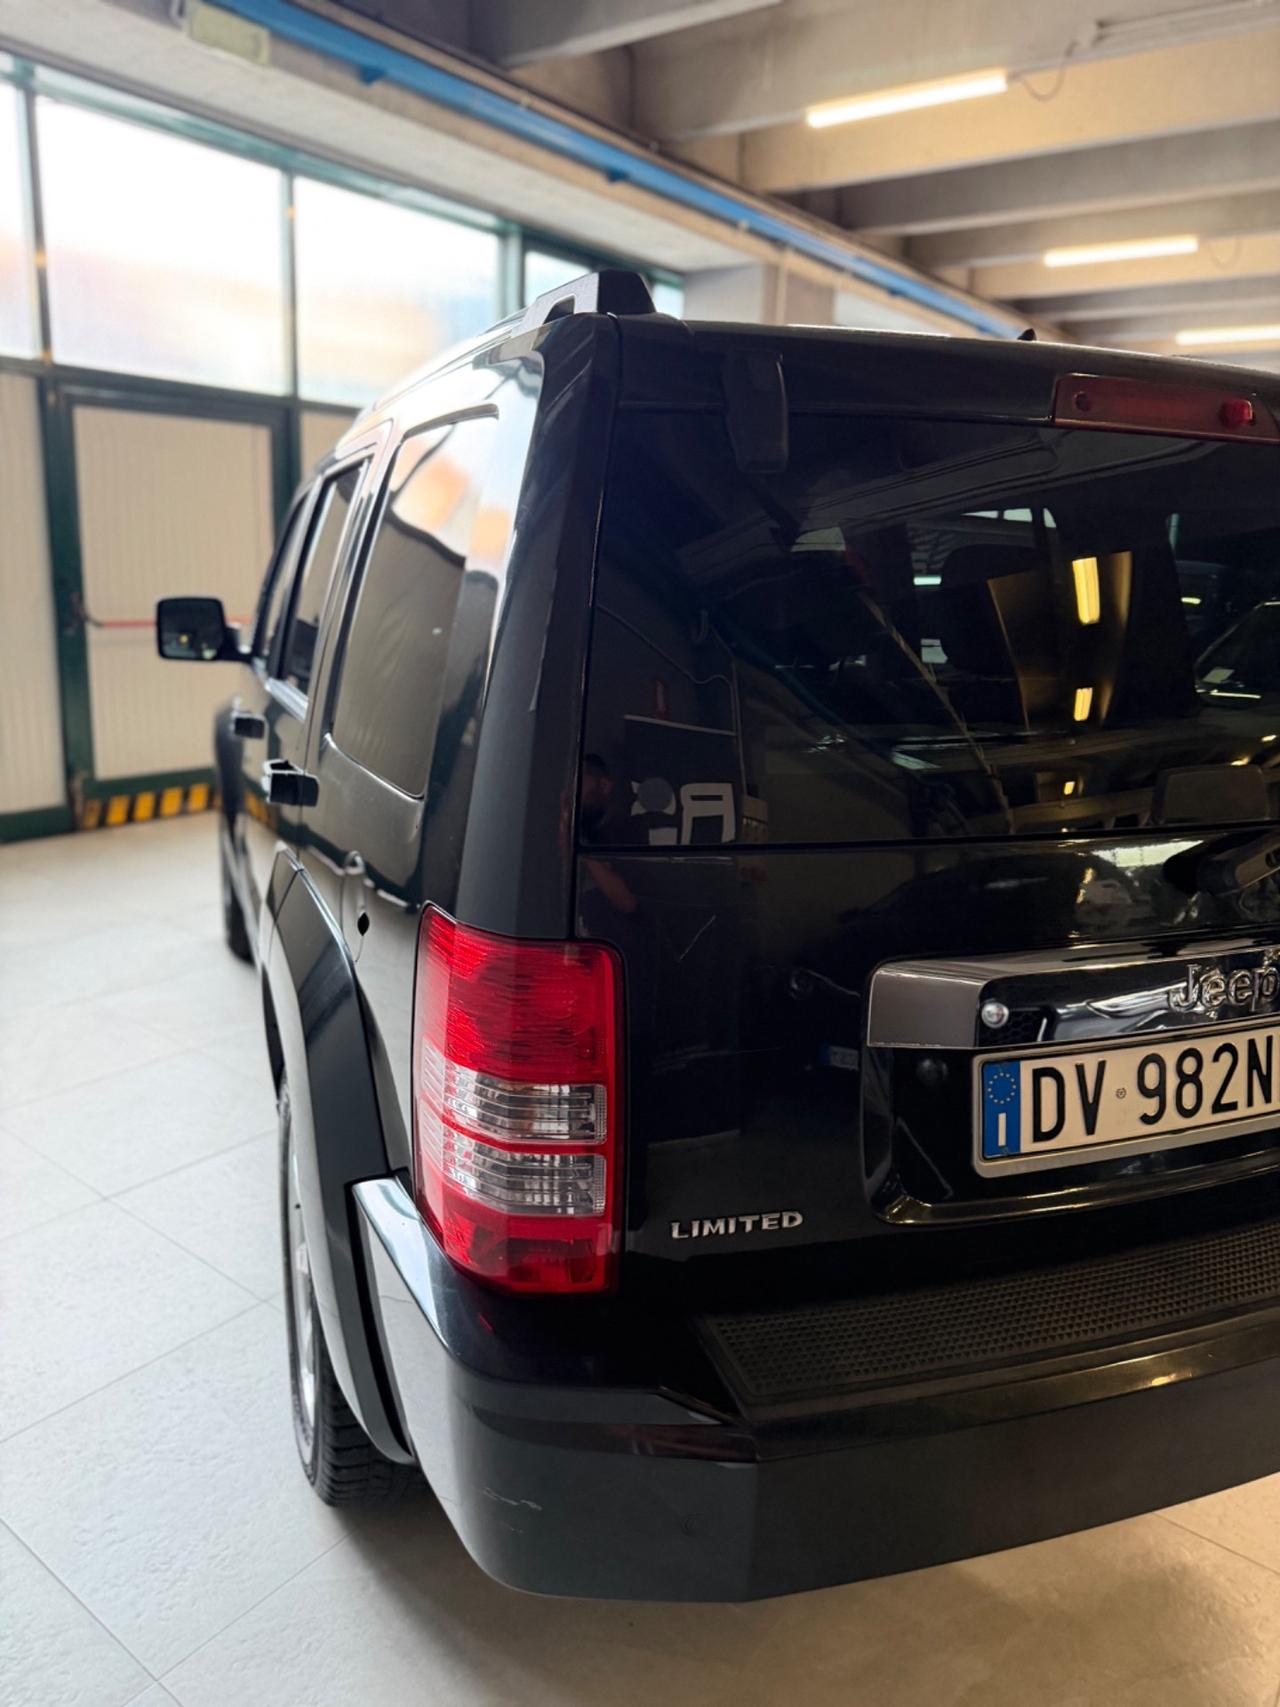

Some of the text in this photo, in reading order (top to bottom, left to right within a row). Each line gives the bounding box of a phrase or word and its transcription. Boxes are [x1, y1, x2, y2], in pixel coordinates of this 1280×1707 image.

[1169, 963, 1280, 1011] Jeep
[1032, 1060, 1107, 1143] DV
[670, 1211, 804, 1239] LIMITED
